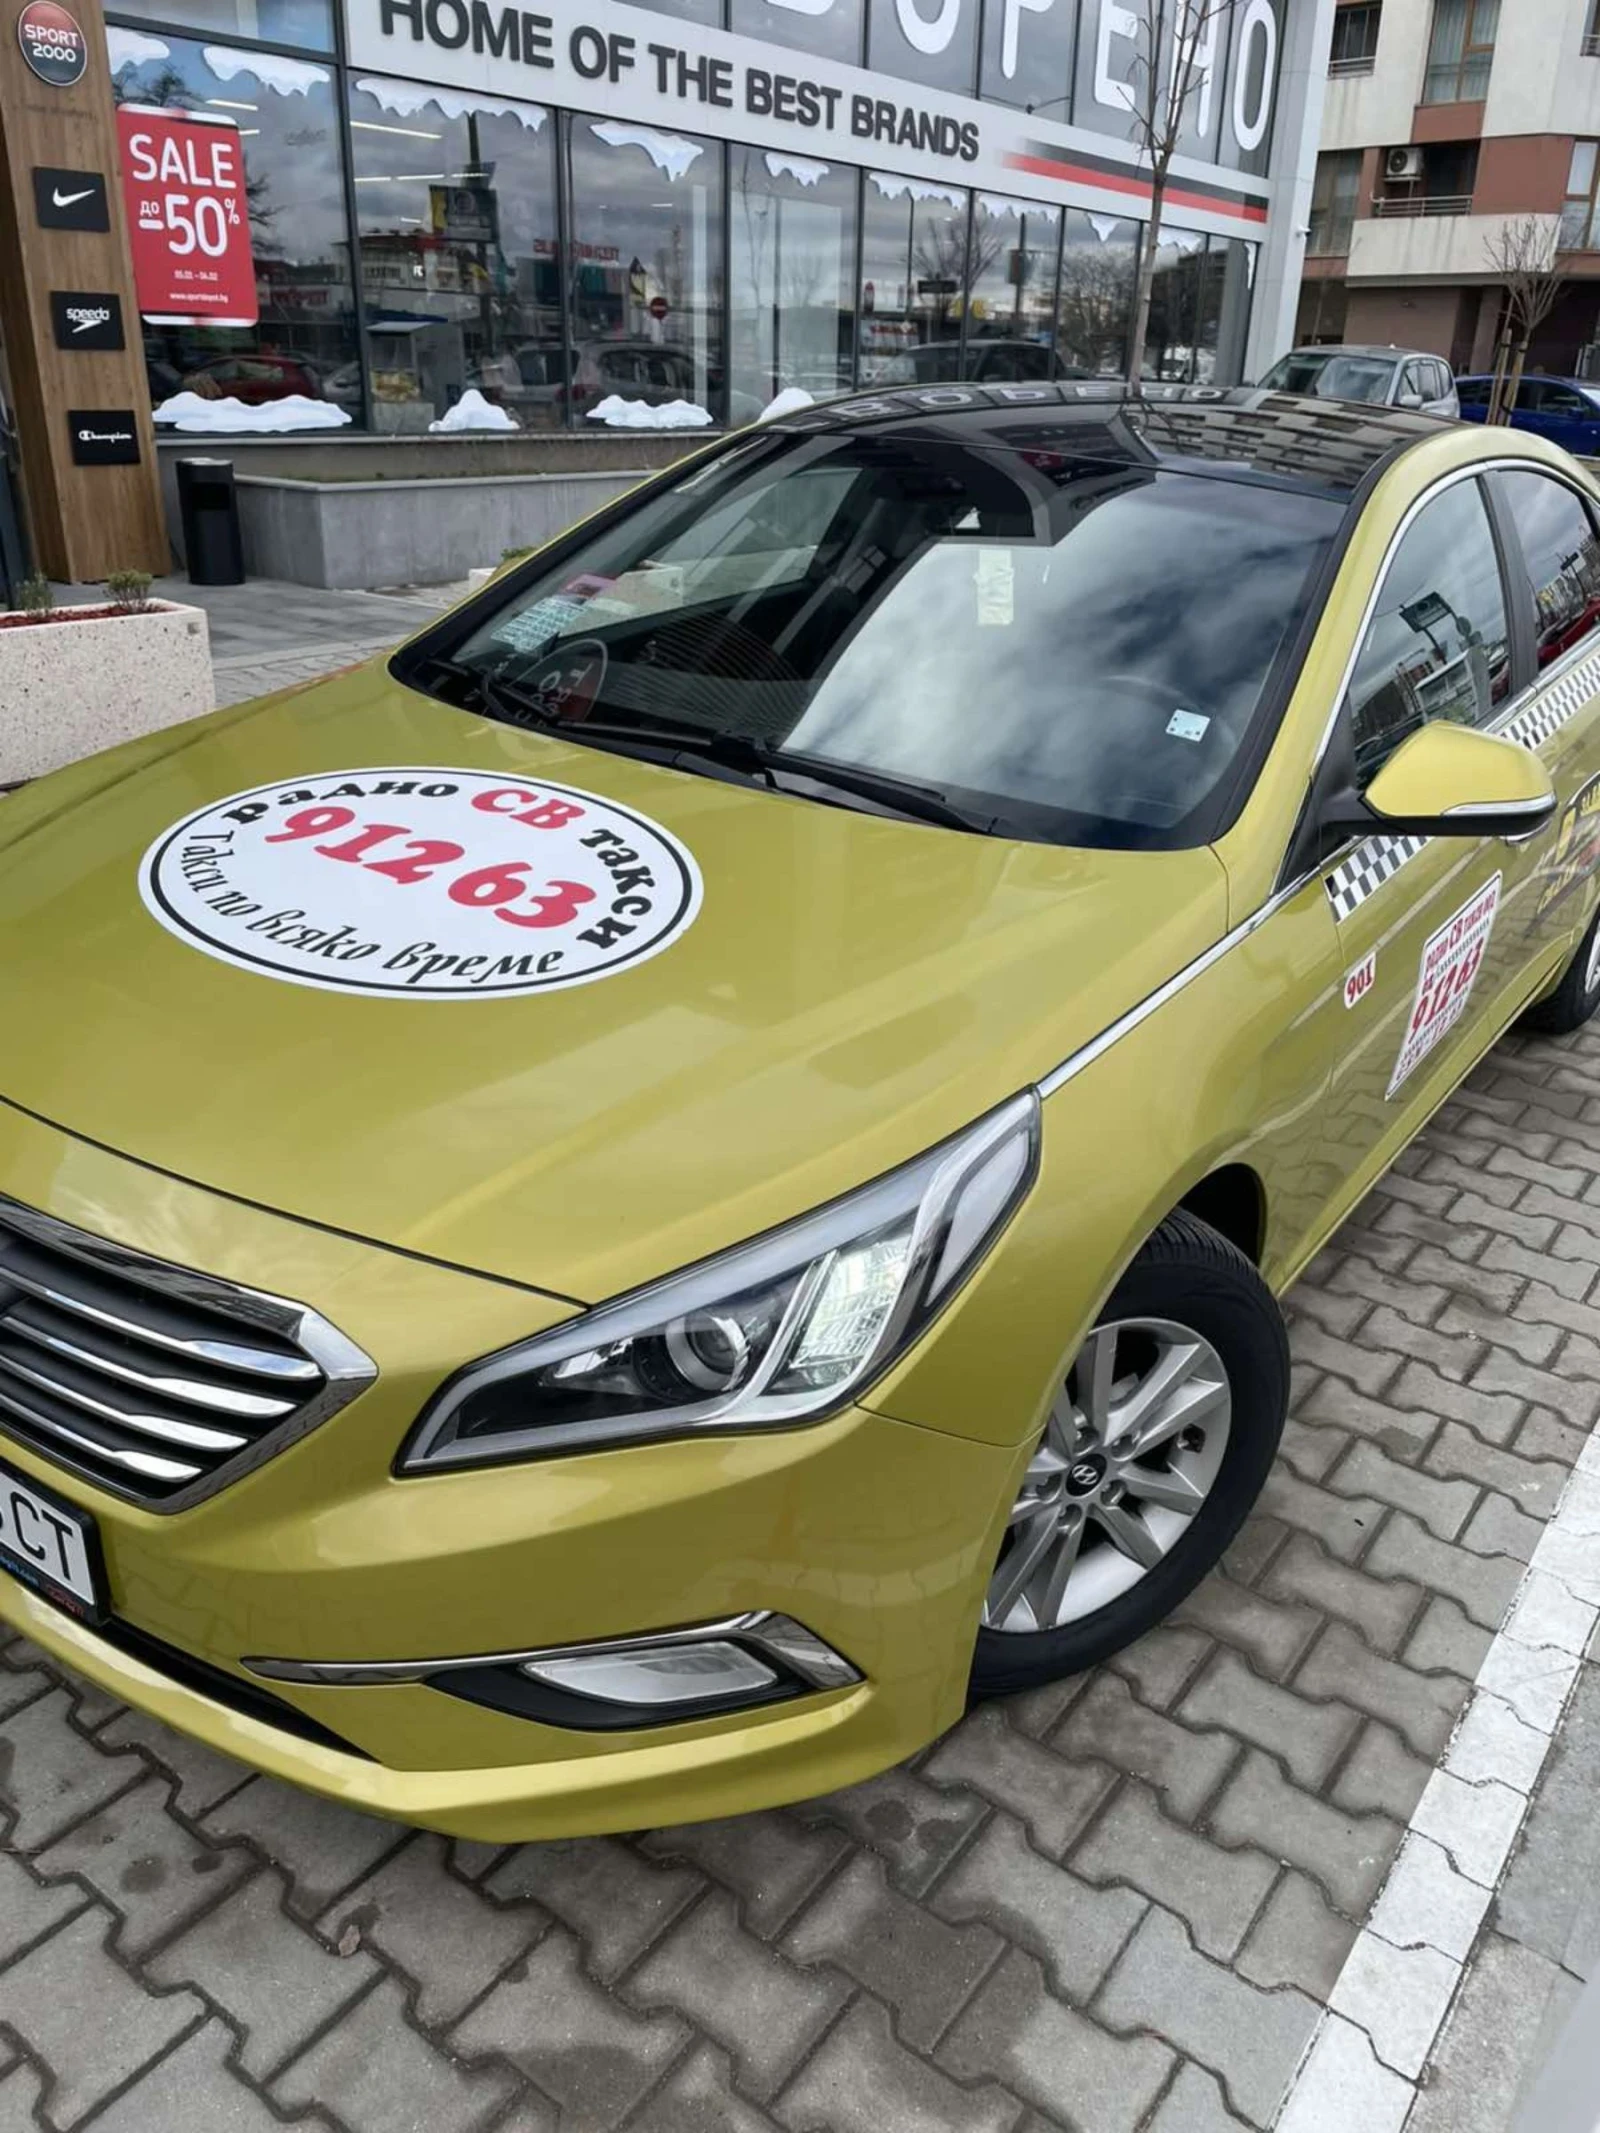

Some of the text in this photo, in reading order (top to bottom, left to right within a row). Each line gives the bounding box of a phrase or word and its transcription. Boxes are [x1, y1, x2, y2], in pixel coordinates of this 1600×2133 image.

[24, 24, 78, 47] SPORT
[32, 42, 76, 63] 2000
[380, 0, 979, 161] HOME OF THE BEST BRANDS
[129, 133, 237, 189] SALE
[66, 307, 110, 322] speedo
[78, 430, 132, 443] Champion
[471, 789, 586, 829] СВ
[205, 890, 262, 917] по
[245, 909, 382, 961] всяко
[382, 942, 565, 983] време
[1347, 957, 1373, 1003] 901
